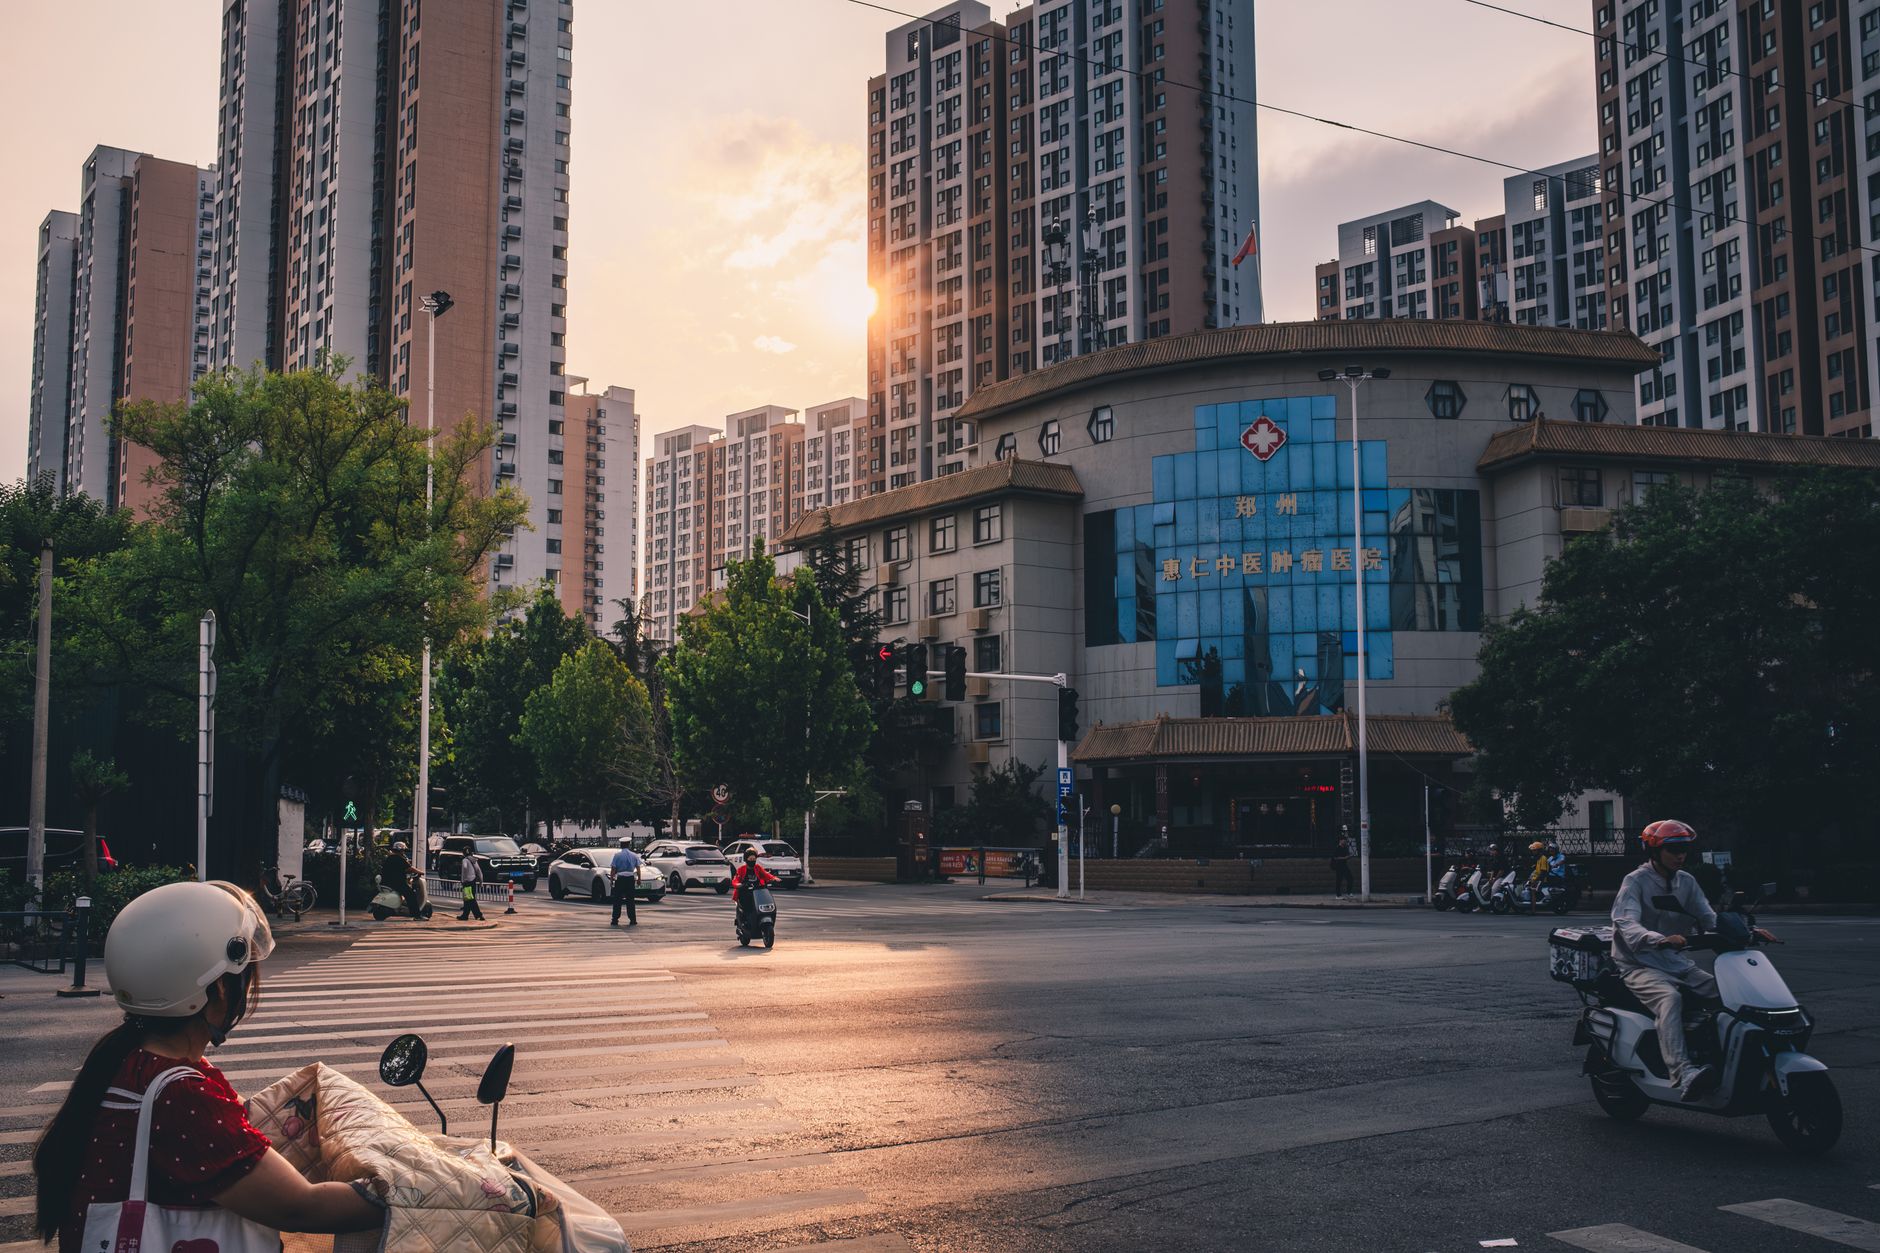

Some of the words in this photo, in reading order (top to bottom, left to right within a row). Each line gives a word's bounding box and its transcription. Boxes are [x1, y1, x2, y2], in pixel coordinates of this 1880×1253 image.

[1235, 494, 1298, 518] 郑州
[1161, 547, 1383, 581] 惠仁中医肿瘤医院
[716, 788, 726, 798] 40
